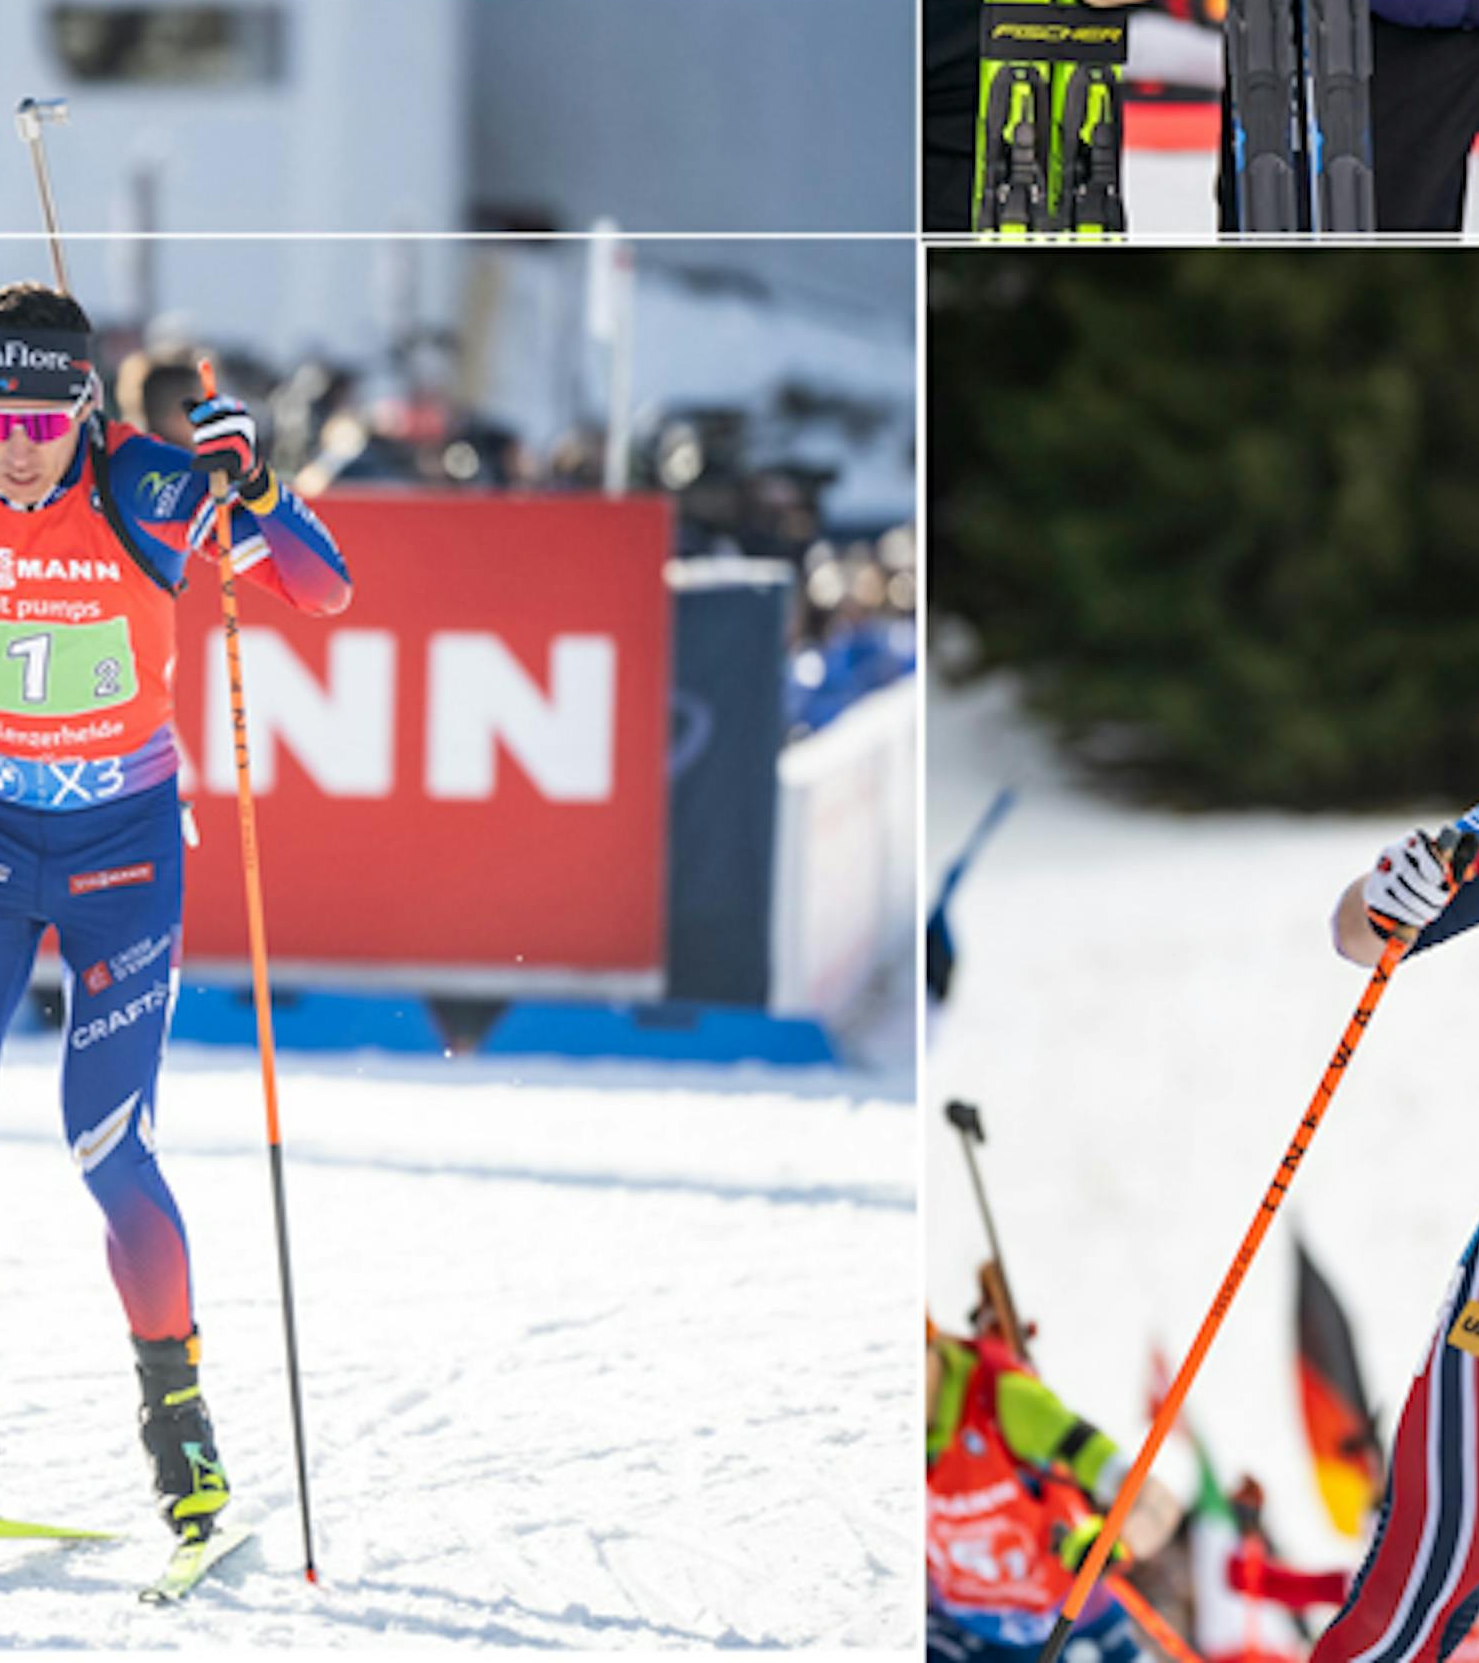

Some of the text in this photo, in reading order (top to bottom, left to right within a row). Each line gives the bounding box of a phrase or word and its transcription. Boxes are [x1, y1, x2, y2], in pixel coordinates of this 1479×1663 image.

[16, 596, 103, 622] pumps
[6, 632, 53, 705] 1
[92, 656, 123, 699] 2
[48, 755, 125, 807] X3
[71, 990, 157, 1051] CRAFT
